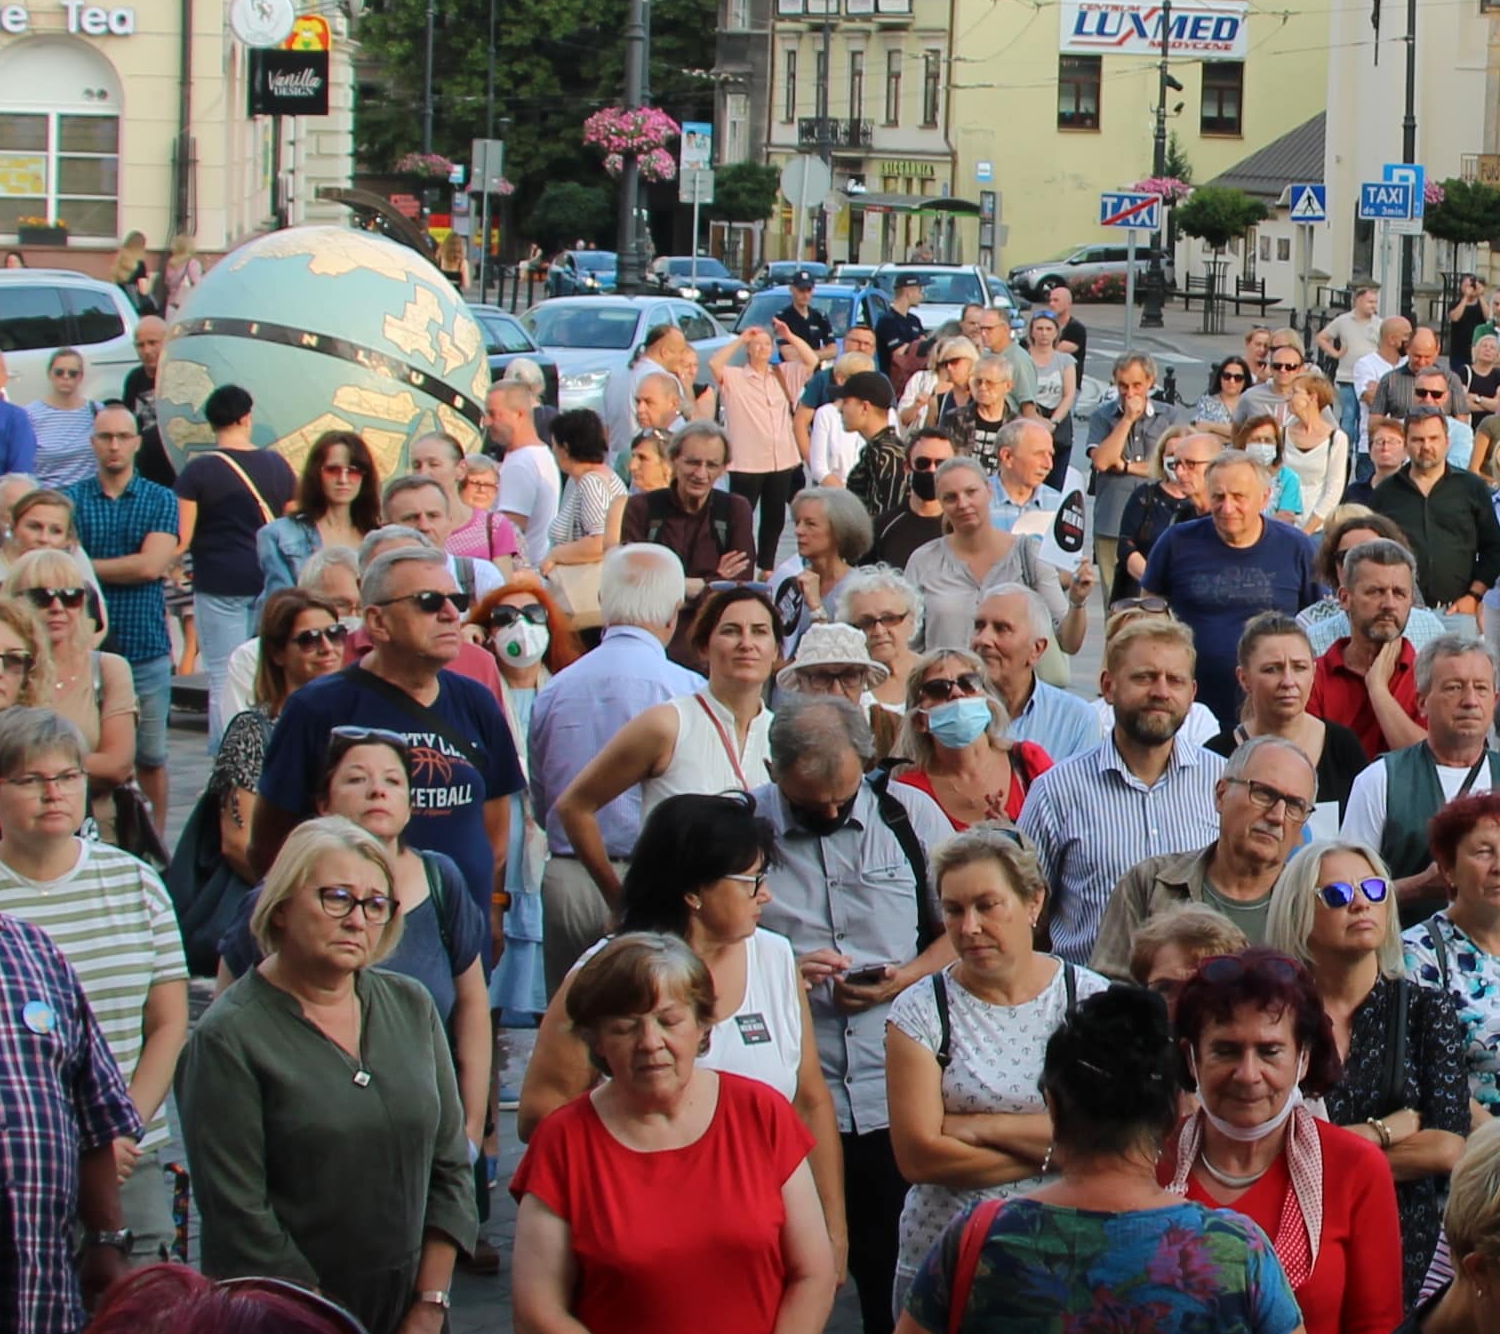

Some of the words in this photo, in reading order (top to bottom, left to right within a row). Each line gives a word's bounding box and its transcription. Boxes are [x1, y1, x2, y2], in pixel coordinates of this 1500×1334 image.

[267, 67, 321, 91] Vanilla
[1367, 186, 1404, 205] TAXI
[1102, 194, 1158, 226] TAXI
